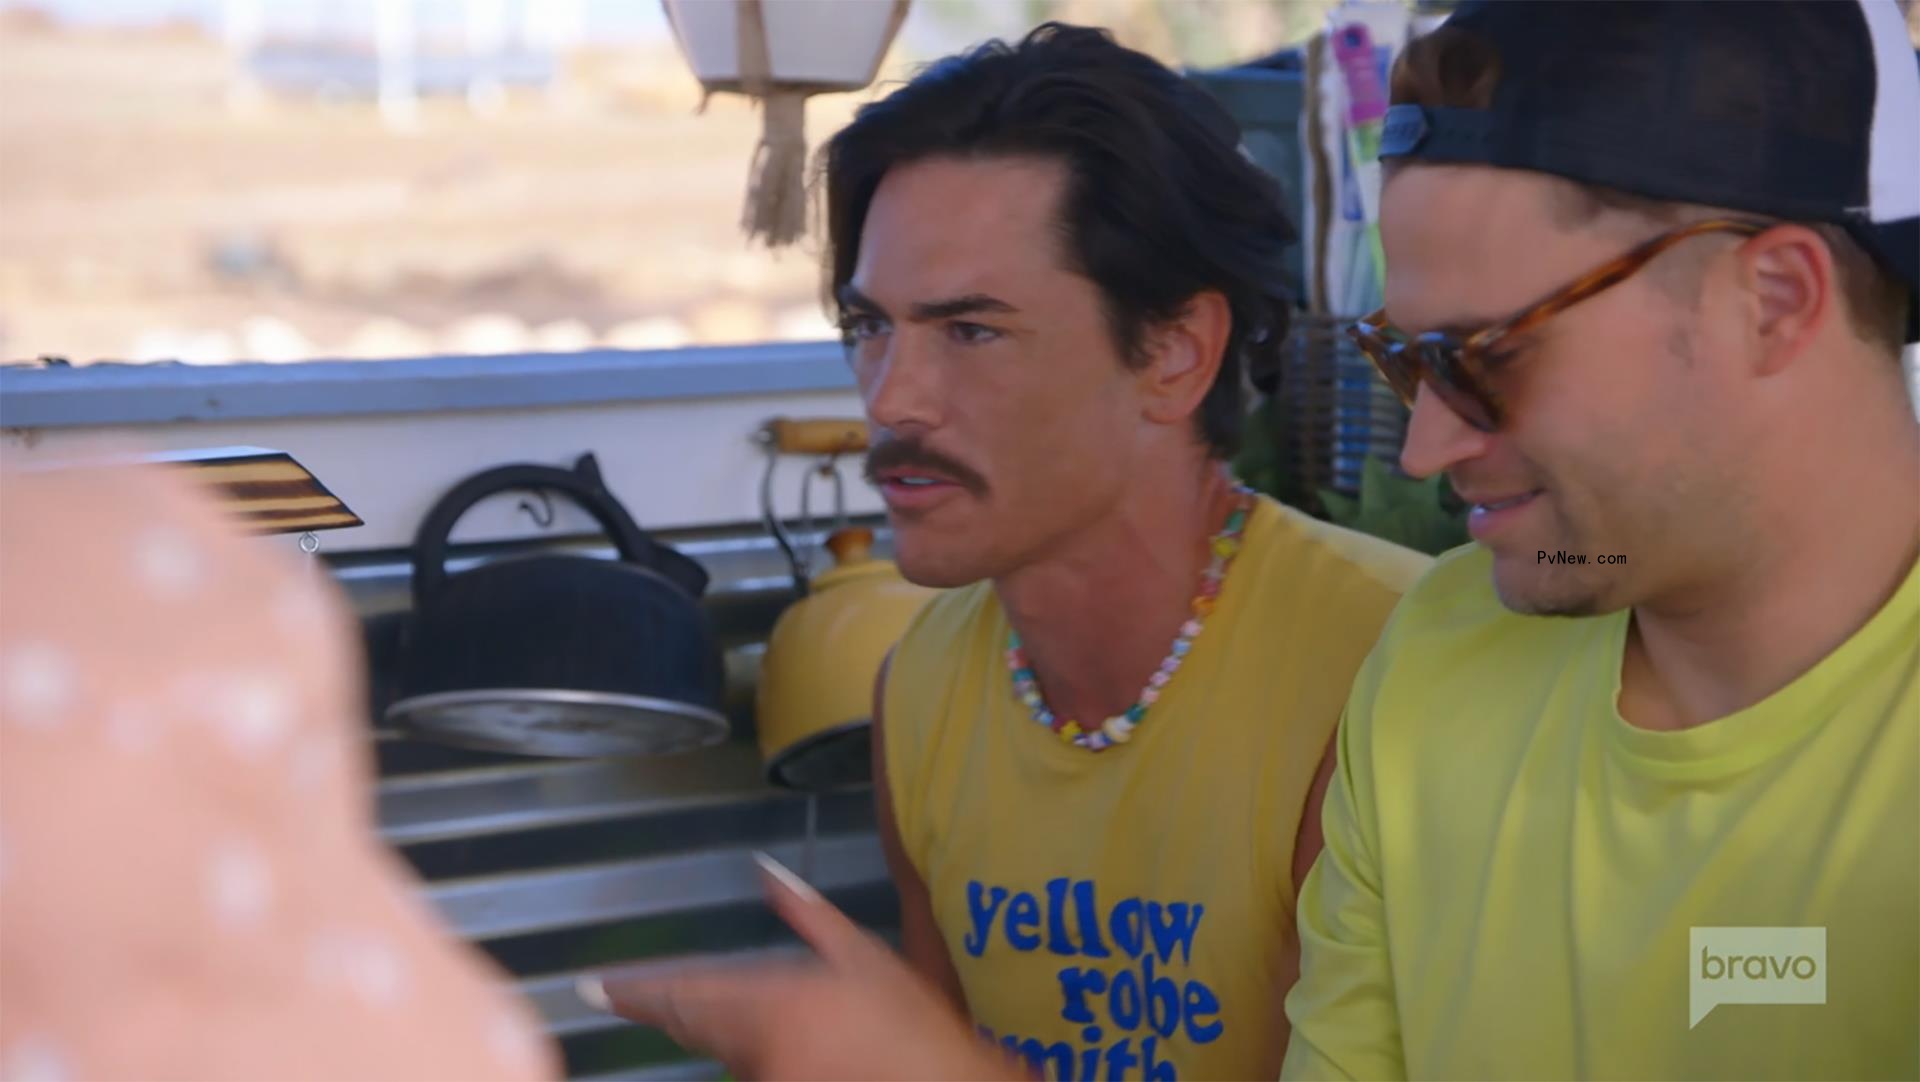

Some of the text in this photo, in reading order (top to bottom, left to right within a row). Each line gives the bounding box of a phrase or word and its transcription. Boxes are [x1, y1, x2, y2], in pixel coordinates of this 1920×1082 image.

[965, 877, 1204, 967] yellow
[1057, 953, 1224, 1045] robe
[976, 1023, 1177, 1082] mith
